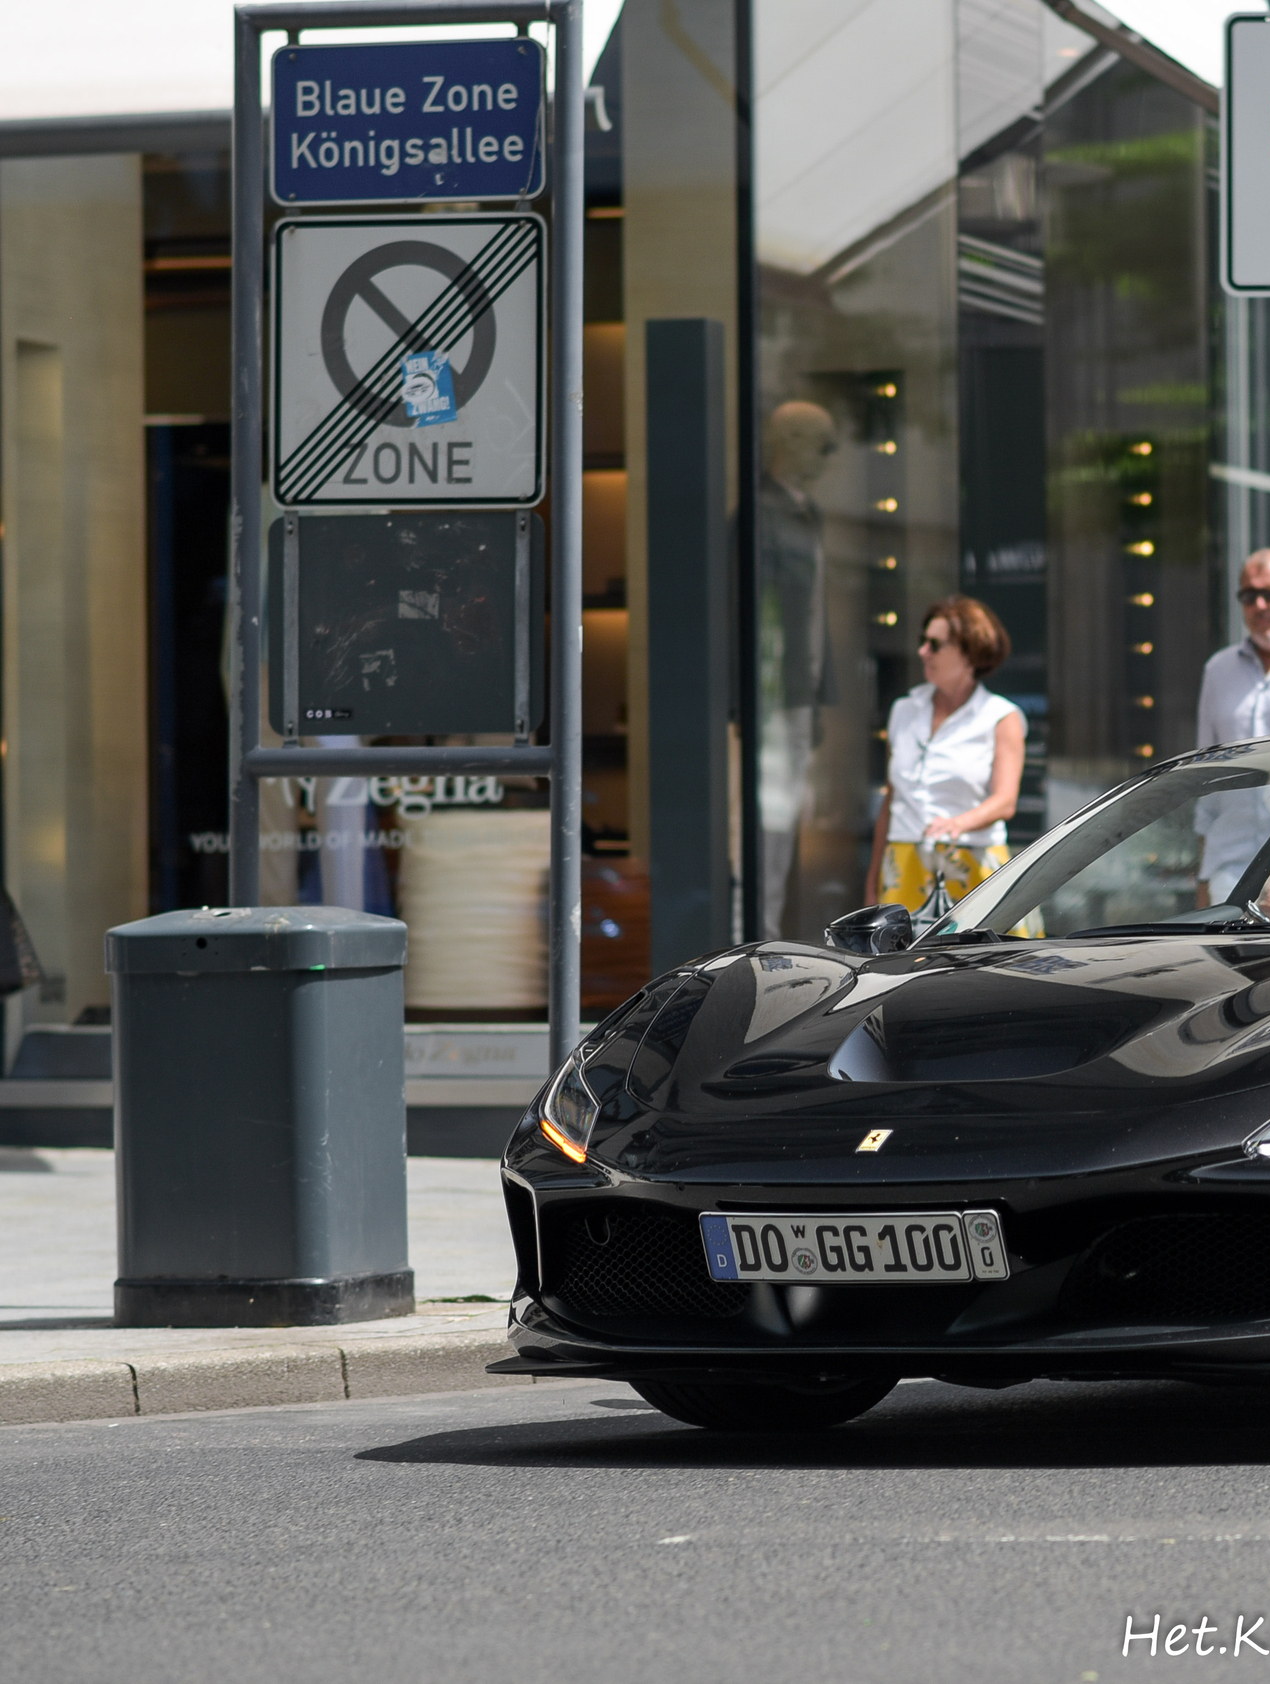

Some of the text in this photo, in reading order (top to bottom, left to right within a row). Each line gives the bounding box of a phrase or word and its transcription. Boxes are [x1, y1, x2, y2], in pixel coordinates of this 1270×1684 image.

[296, 76, 518, 117] Blaue Zone
[291, 127, 524, 176] Königsallee
[342, 442, 473, 485] ZONE
[189, 832, 230, 853] YOU
[716, 1253, 728, 1268] D
[731, 1223, 789, 1273] DO
